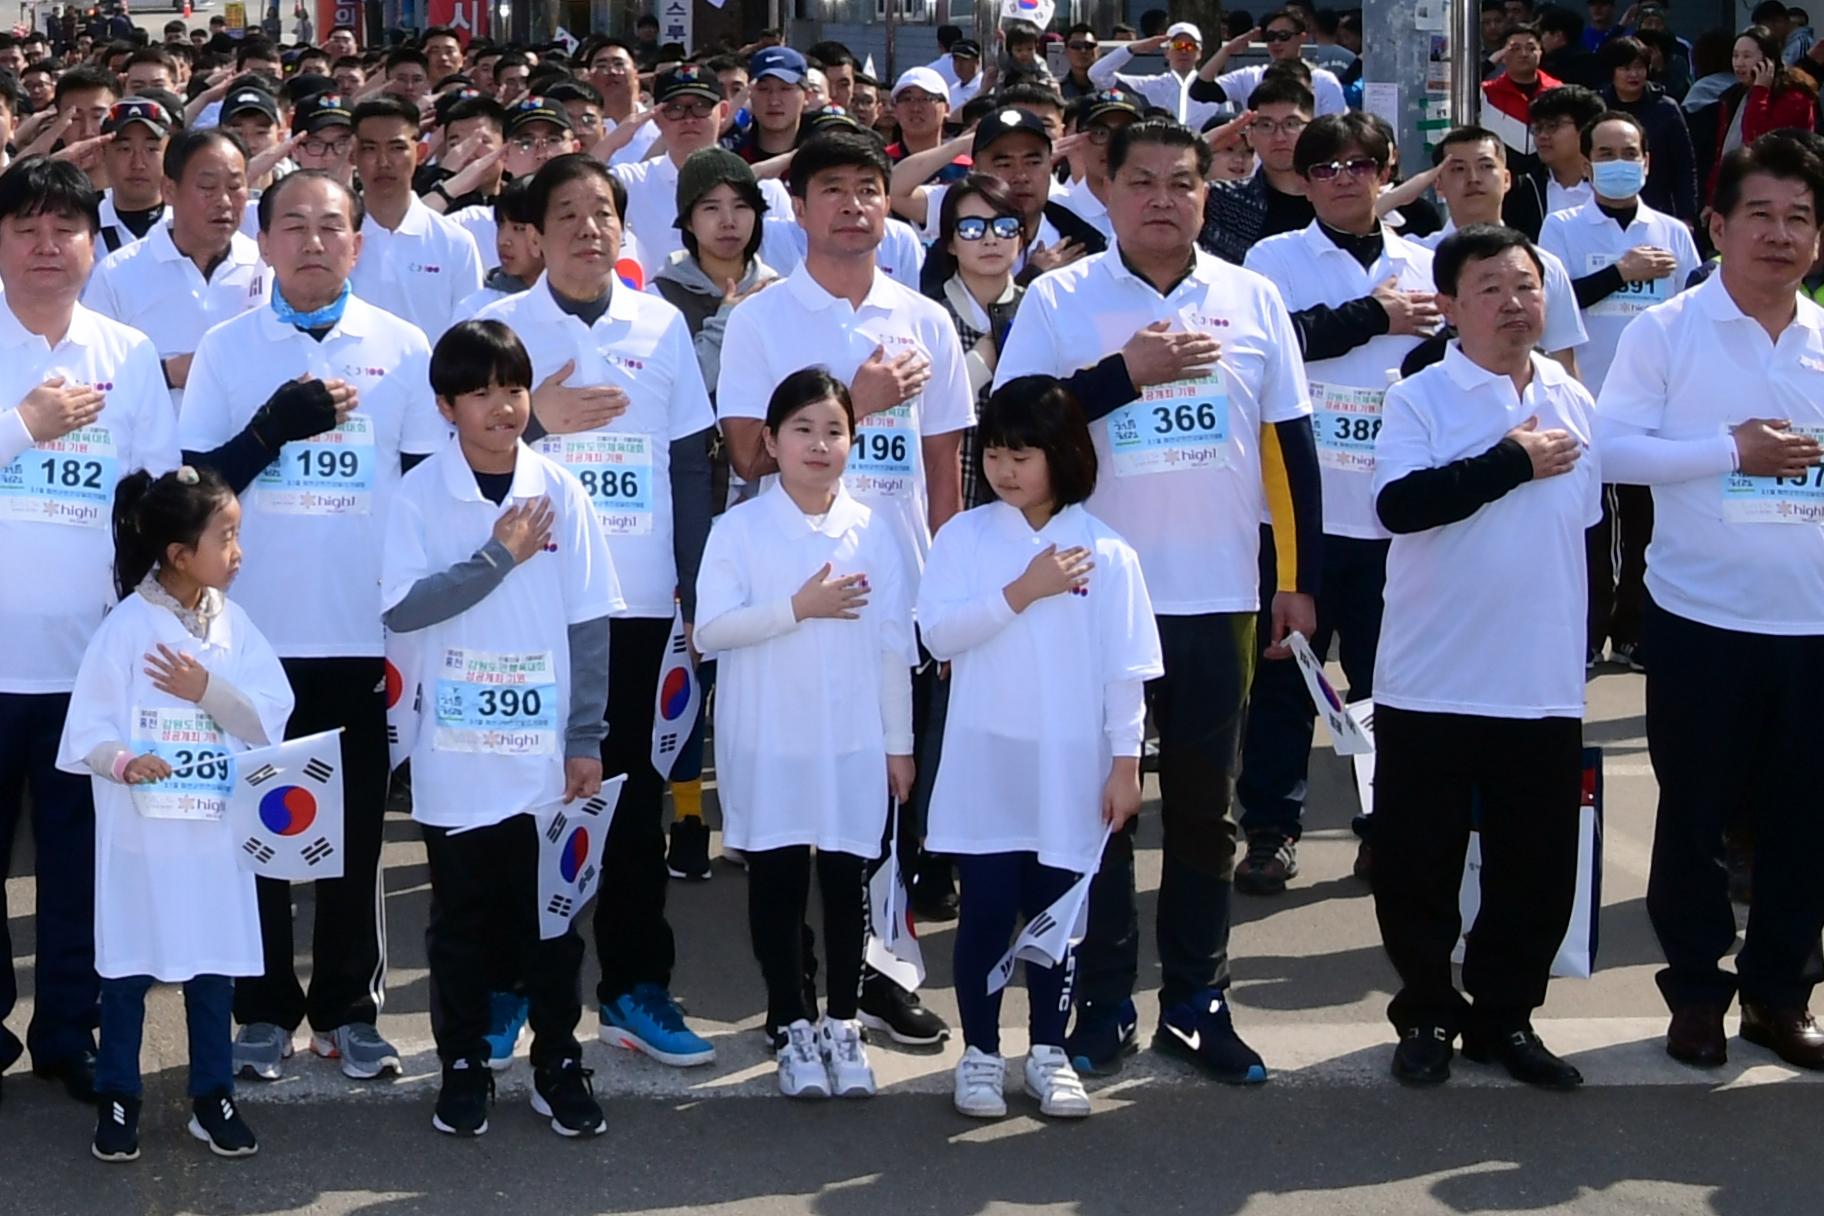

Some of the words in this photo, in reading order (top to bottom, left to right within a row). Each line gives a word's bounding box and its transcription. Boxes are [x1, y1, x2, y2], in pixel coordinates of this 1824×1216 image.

[1152, 403, 1216, 434] 366
[853, 434, 906, 462] 196
[41, 458, 103, 490] 182
[296, 449, 359, 478] 199
[579, 470, 639, 498] 886
[478, 689, 541, 716] 390
